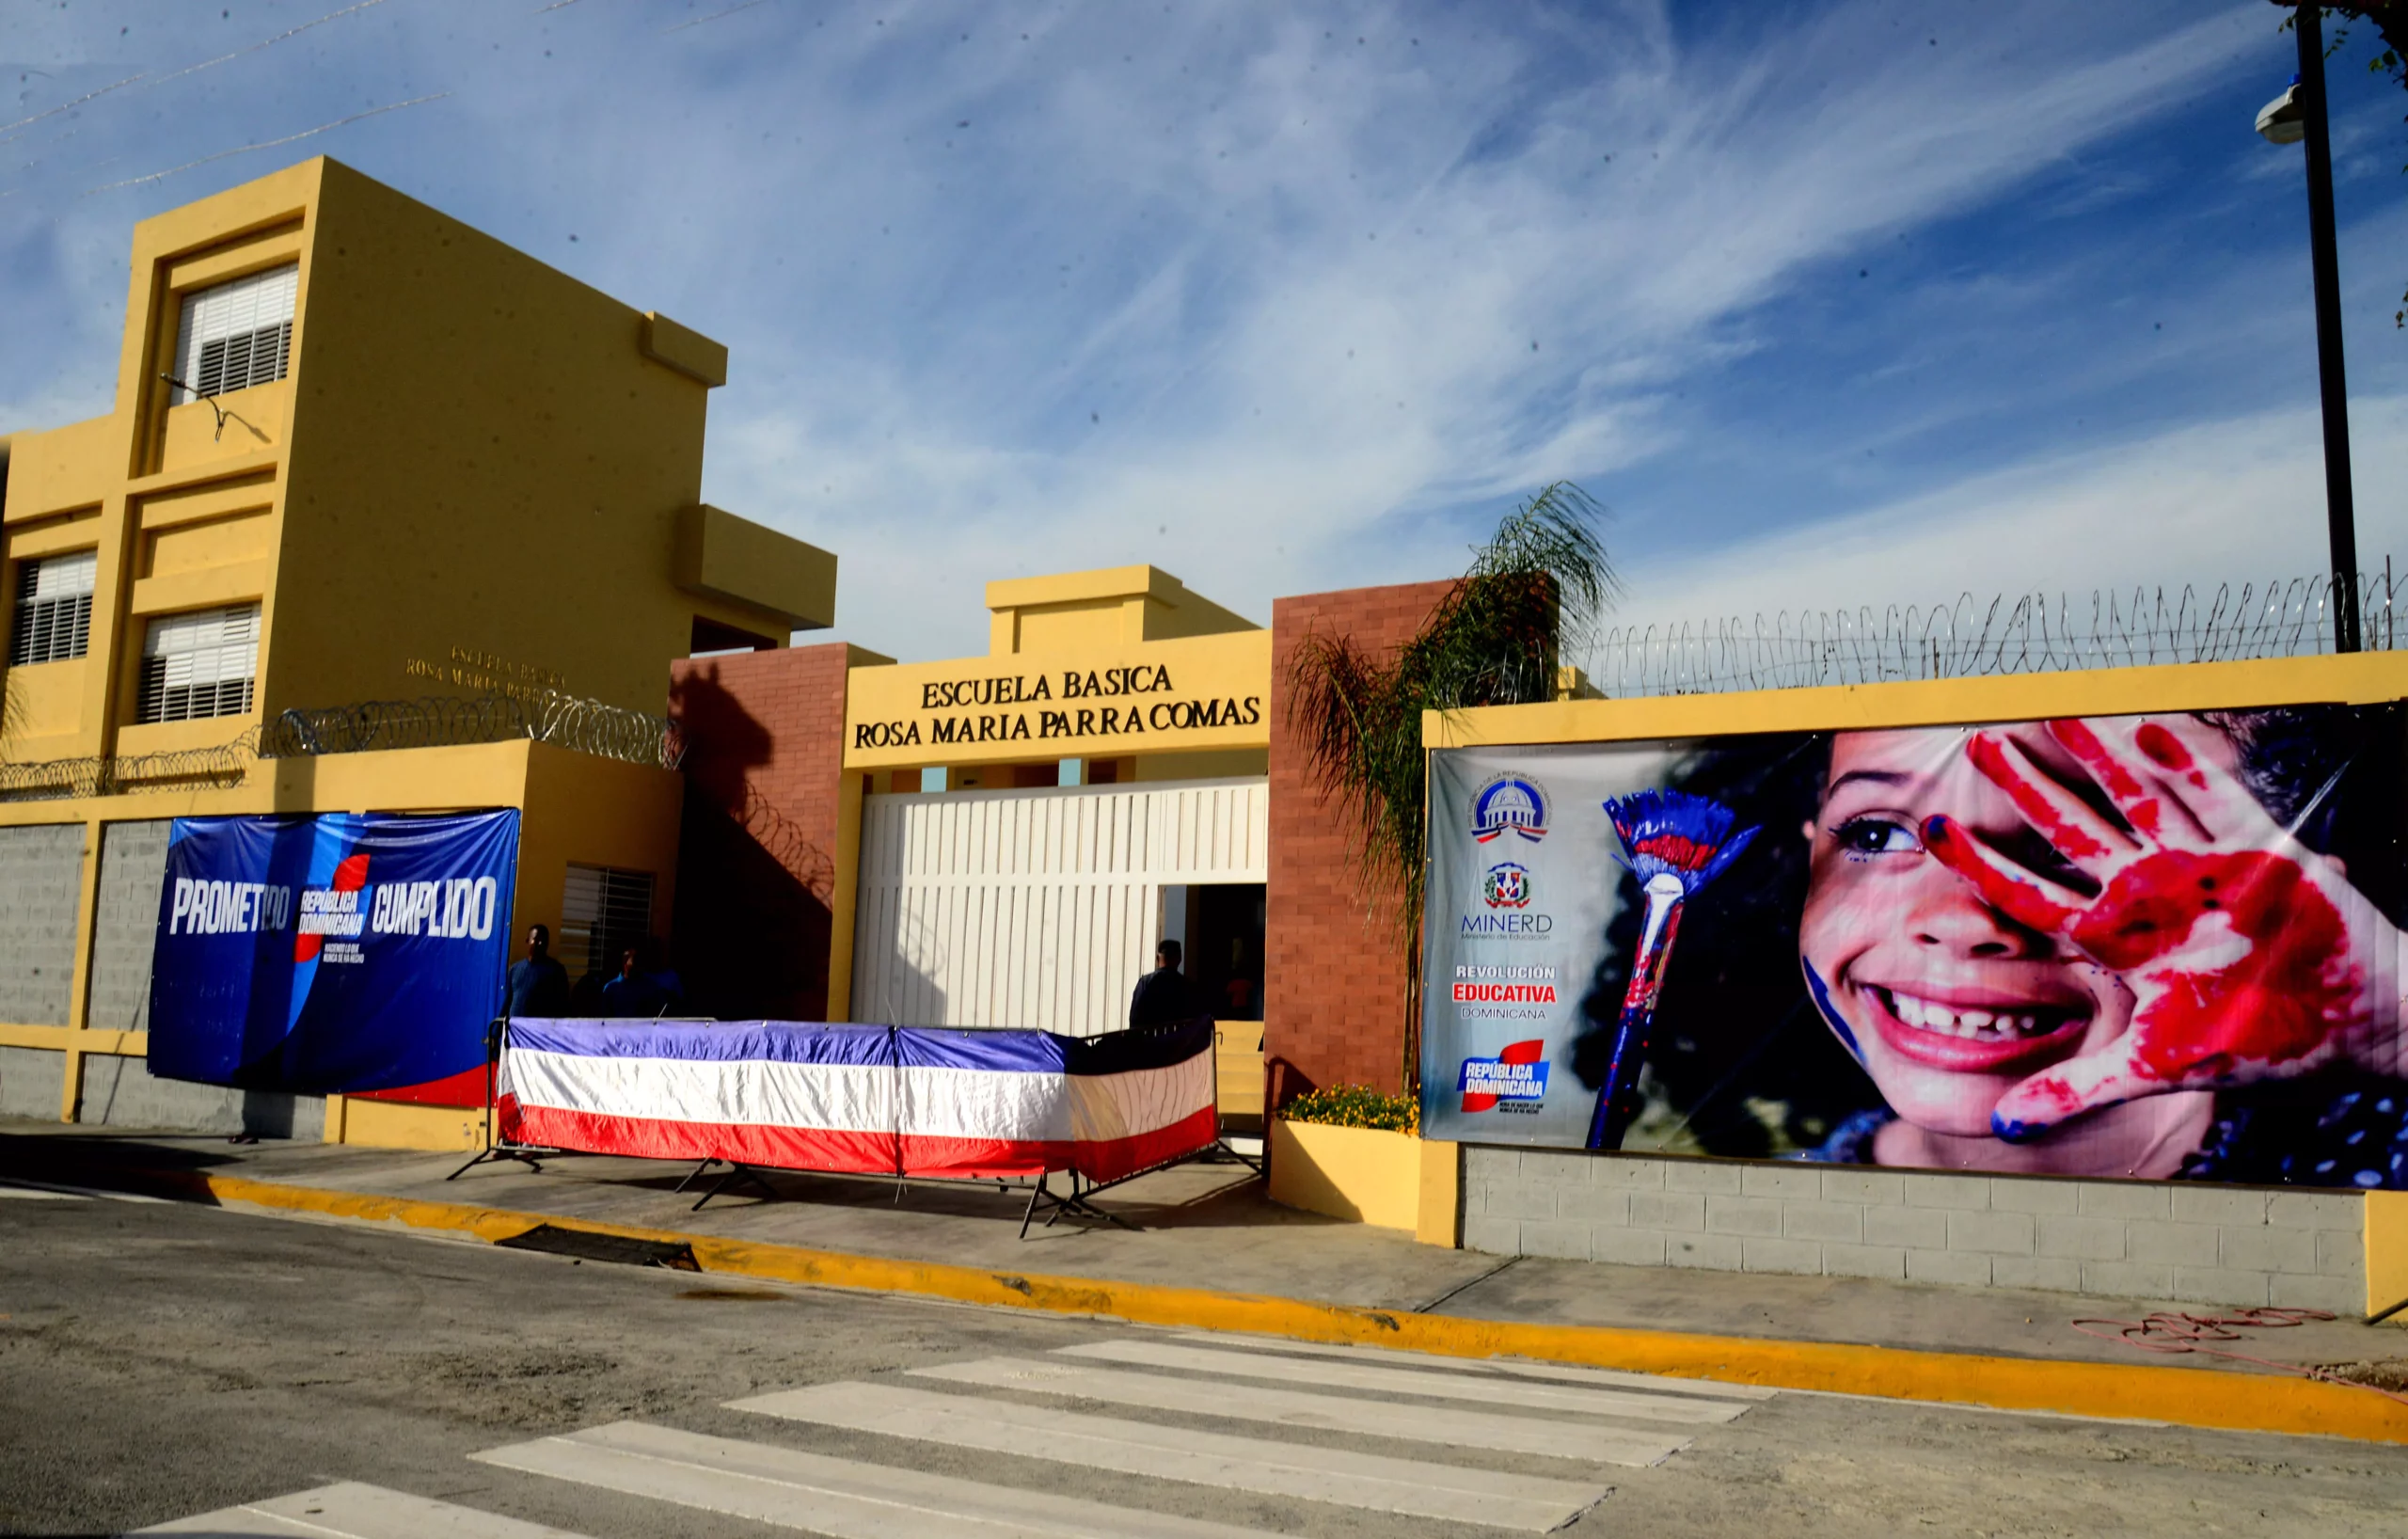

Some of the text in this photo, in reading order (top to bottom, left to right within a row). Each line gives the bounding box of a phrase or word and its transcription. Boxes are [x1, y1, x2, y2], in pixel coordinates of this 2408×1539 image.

[451, 644, 513, 675] ESCUELA
[406, 658, 443, 682] ROSA
[451, 668, 499, 693] MARIA
[921, 663, 1173, 709] ESCUELA BASICA
[854, 696, 1260, 749] ROSA MARIA PARRA COMAS
[168, 876, 497, 941] PROMETIDO CUMPLIDO
[300, 887, 358, 912] REPÚBLICA
[298, 912, 364, 936] DOMINICANA
[1462, 914, 1552, 932] MINERD
[1456, 964, 1556, 979] REVOLUCIÓN
[1452, 982, 1557, 1003] EDUCATIVA
[1462, 1007, 1546, 1020] DOMINICANA
[1465, 1060, 1533, 1080] REPÚBLICA
[1465, 1080, 1543, 1097] DOMINICANA
